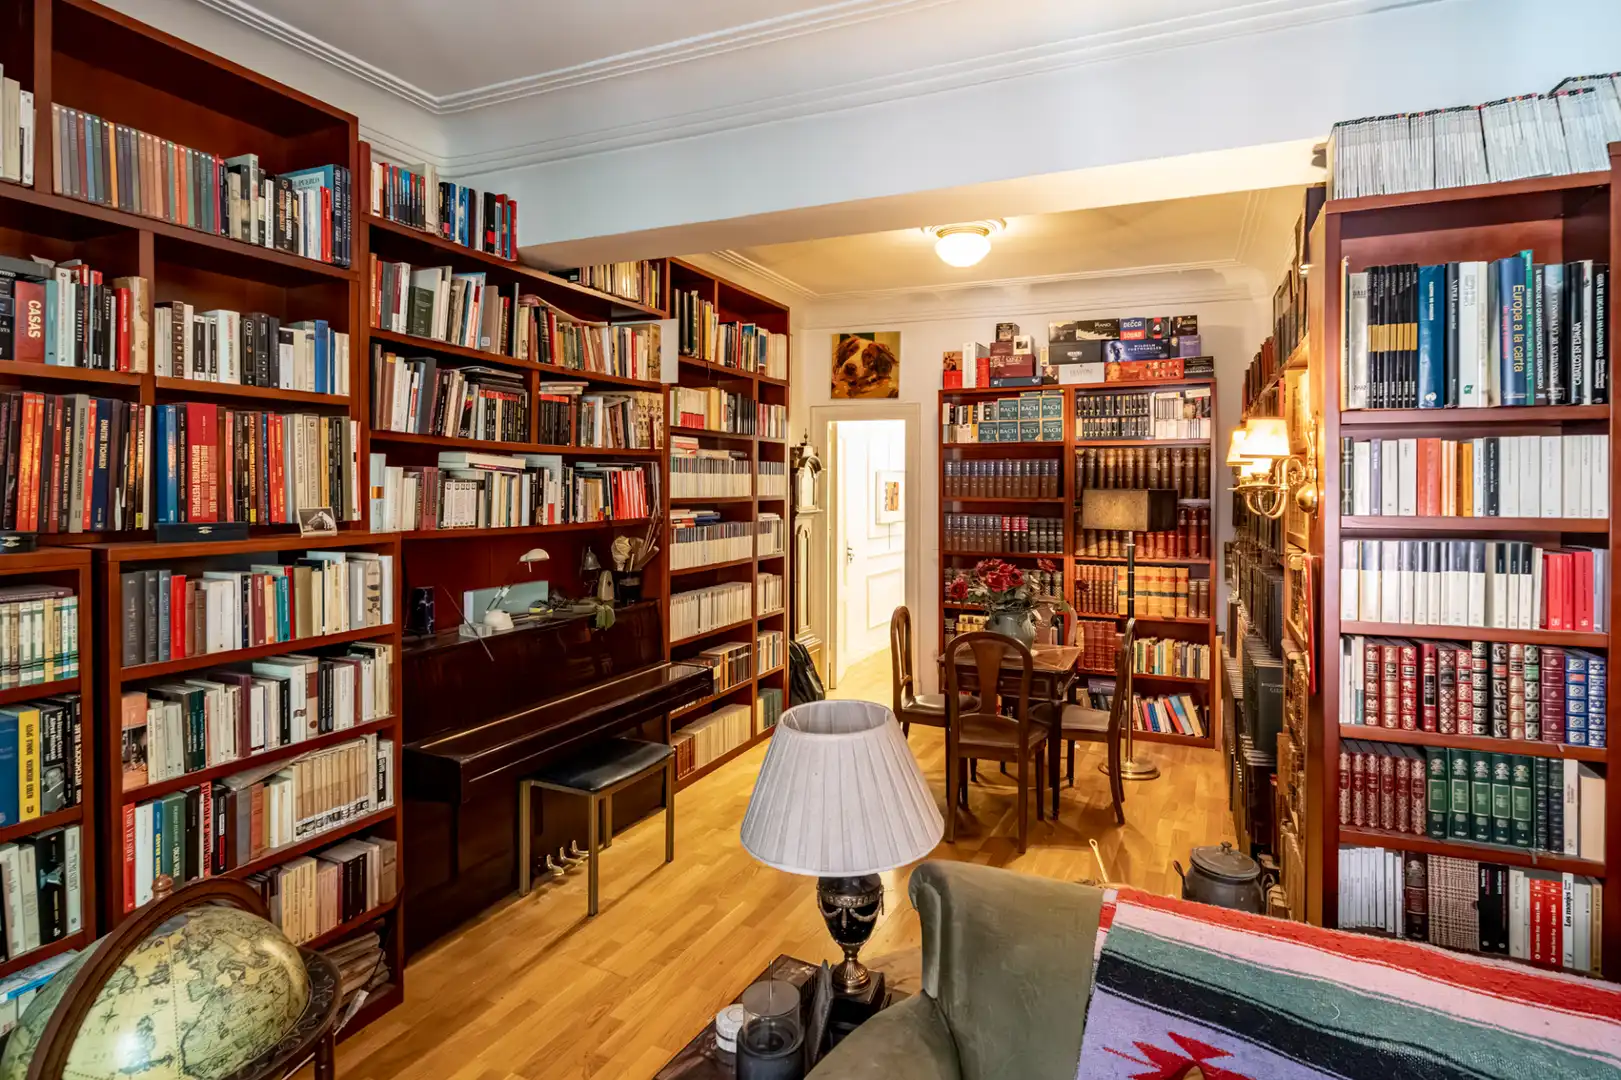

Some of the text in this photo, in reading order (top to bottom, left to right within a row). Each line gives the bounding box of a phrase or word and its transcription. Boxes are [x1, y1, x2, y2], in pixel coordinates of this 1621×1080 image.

[28, 299, 42, 338] CASAS
[1596, 294, 1604, 320] LUGARES
[1512, 284, 1526, 373] Europa a la carta
[1572, 321, 1582, 344] ESPAÑA
[1572, 354, 1582, 385] CABALLOS
[99, 418, 109, 469] DIMITRI TIOMKIN
[192, 444, 201, 516] BAYREUTHER FESTSPIELE
[25, 723, 33, 737] SPOTO
[73, 742, 81, 785] HITCHCOCK'S
[1563, 891, 1573, 915] monjes
[1563, 915, 1571, 927] Los
